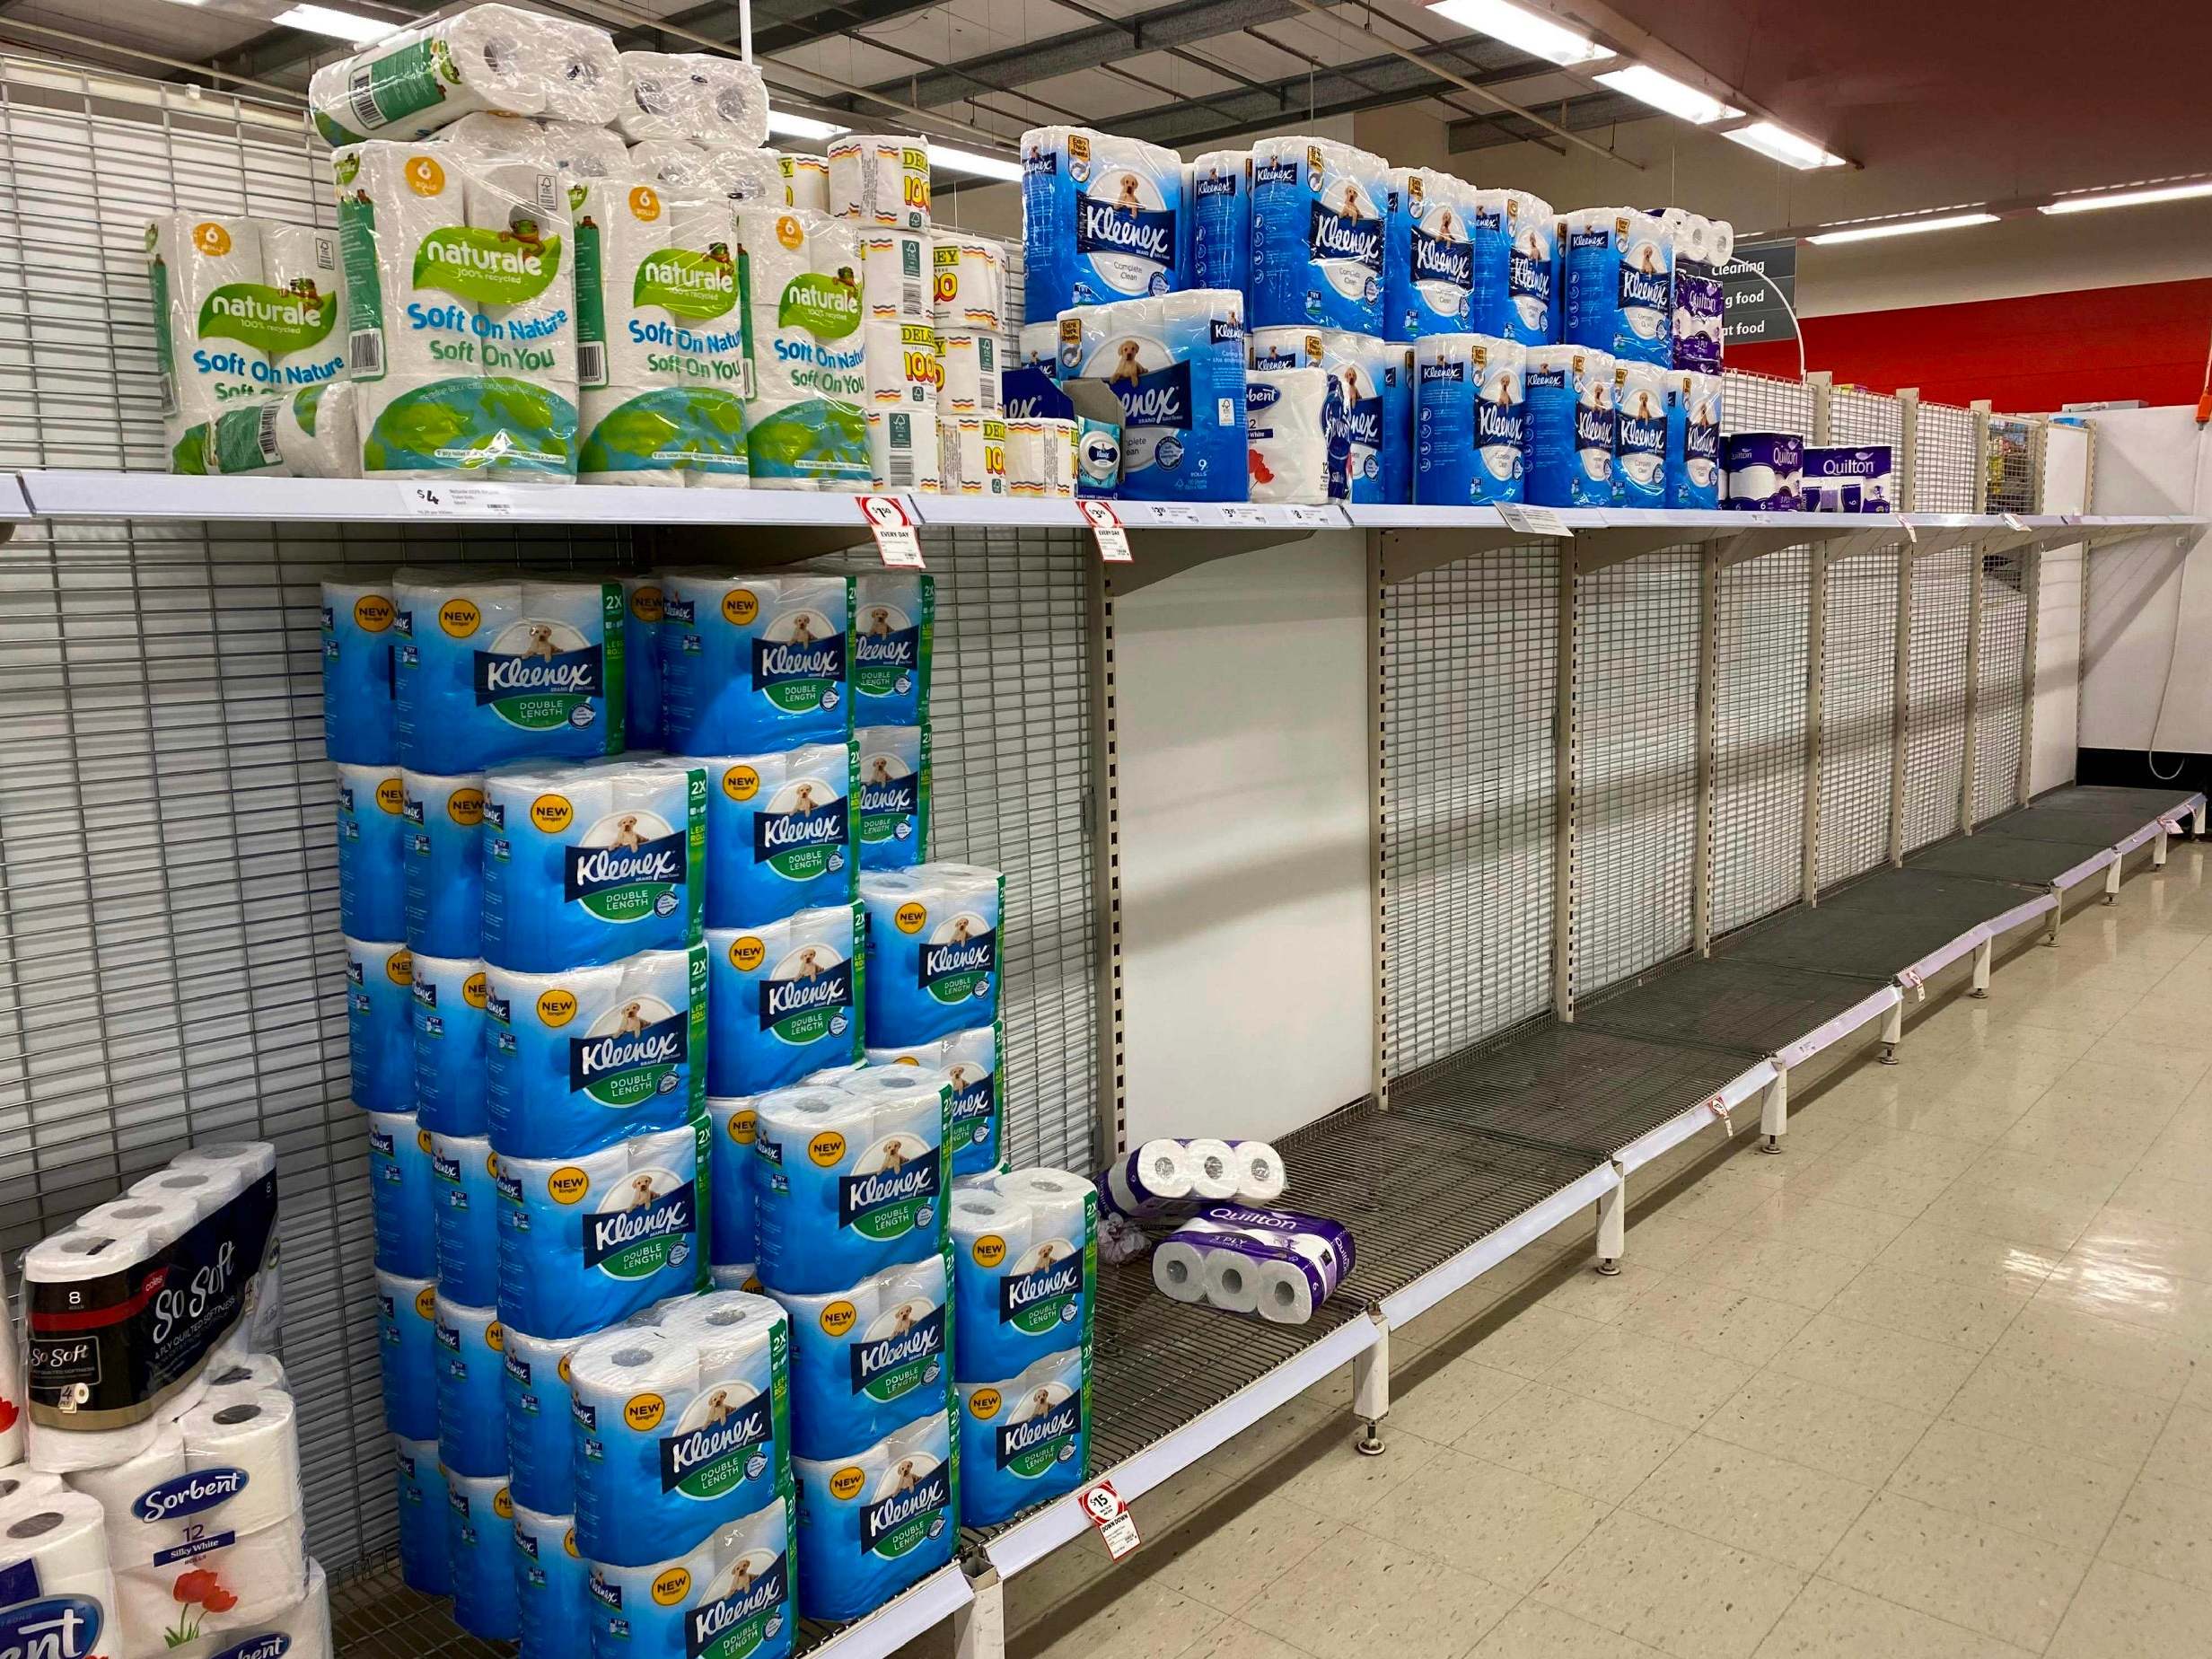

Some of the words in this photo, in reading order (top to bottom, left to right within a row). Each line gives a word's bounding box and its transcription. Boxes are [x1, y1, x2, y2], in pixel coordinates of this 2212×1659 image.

[417, 162, 432, 180] 6
[1257, 169, 1294, 180] Kleenex
[1198, 181, 1231, 194] Kleenex
[639, 190, 650, 206] 6
[206, 227, 219, 243] 6
[785, 220, 795, 235] 6
[1086, 206, 1168, 258] Kleenex
[1316, 214, 1379, 259] Kleenex
[1573, 235, 1605, 247] Kleenex
[427, 241, 542, 276] naturale
[1113, 261, 1143, 273] Complete
[1712, 260, 1764, 276] Cleaning
[485, 273, 522, 284] recycled
[645, 261, 733, 293] naturale
[789, 285, 859, 313] naturale
[1736, 289, 1764, 304] food
[212, 295, 321, 328] naturale
[241, 319, 265, 329] 100%
[267, 325, 301, 334] recycled
[408, 303, 464, 332] Soft
[471, 314, 504, 340] On
[508, 309, 568, 340] Nature
[1736, 320, 1765, 335] food
[628, 320, 673, 344] Soft
[677, 330, 704, 354] On
[430, 339, 474, 363] Soft
[481, 345, 512, 368] On
[514, 347, 556, 370] You
[816, 347, 836, 369] On
[193, 350, 245, 375] Soft
[250, 361, 281, 383] On
[286, 356, 345, 384] Nature
[647, 354, 682, 373] Soft
[686, 356, 709, 379] On
[713, 359, 741, 380] You
[1258, 360, 1289, 371] Kleenex
[1424, 366, 1461, 379] Kleenex
[791, 369, 818, 388] Soft
[821, 373, 841, 393] On
[843, 373, 865, 394] You
[1527, 374, 1561, 387] Kleenex
[1249, 389, 1277, 402] bent
[1122, 386, 1180, 424] enex
[1620, 417, 1665, 451] Kleenex
[1198, 459, 1207, 470] 9
[1773, 447, 1798, 466] Quilton
[1823, 459, 1874, 476] Quilton
[1760, 501, 1766, 510] 6
[606, 595, 622, 610] 2X
[727, 601, 753, 610] NEW
[359, 607, 390, 618] NEW
[444, 612, 475, 621] NEW
[856, 637, 911, 664] leenex
[762, 645, 838, 677] Kleenex
[487, 657, 592, 692] Kleenex
[861, 672, 891, 680] DOUBLE
[861, 677, 890, 685] LENGTH
[785, 685, 816, 695] DOUBLE
[785, 692, 816, 702] LENGTH
[520, 700, 563, 710] DOUBLE
[521, 708, 563, 718] LENGTH
[691, 781, 707, 795] 2X
[728, 777, 755, 786] NEW
[452, 801, 484, 811] NEW
[861, 786, 910, 813] leenex
[536, 806, 567, 817] NEW
[765, 814, 840, 848] Kleenex
[864, 819, 891, 829] DOUBLE
[864, 825, 890, 835] LENGTH
[788, 850, 822, 864] DOUBLE
[789, 857, 822, 872] LENGTH
[576, 849, 676, 887] Kleenex
[606, 890, 648, 903] DOUBLE
[606, 898, 648, 911] LENGTH
[900, 913, 923, 921] NEW
[734, 947, 760, 957] NEW
[927, 945, 988, 976] Kleenex
[692, 960, 707, 976] 2X
[692, 961, 707, 976] 2X
[944, 977, 971, 989] DOUBLE
[944, 983, 971, 996] LENGTH
[769, 979, 844, 1014] Kleenex
[542, 1001, 572, 1014] NEW
[791, 1014, 823, 1028] DOUBLE
[791, 1021, 823, 1035] LENGTH
[582, 1032, 678, 1075] Kleenex
[610, 1073, 652, 1090] DOUBLE
[611, 1082, 652, 1097] LENGTH
[698, 1128, 711, 1145] 2X
[813, 1141, 841, 1154] NEW
[553, 1177, 584, 1189] NEW
[850, 1168, 932, 1211] Kleenex
[874, 1207, 908, 1224] DOUBLE
[876, 1214, 909, 1231] LENGTH
[1210, 1208, 1296, 1230] Quilton
[595, 1205, 686, 1251] Kleenex
[623, 1243, 662, 1262] DOUBLE
[977, 1244, 1002, 1256] NEW
[624, 1252, 662, 1270] LENGTH
[145, 1275, 163, 1292] coles
[153, 1288, 185, 1344] So
[189, 1240, 234, 1318] Soft
[1009, 1270, 1076, 1309] Kleenex
[69, 1291, 81, 1304] 8
[825, 1312, 852, 1322] NEW
[1029, 1303, 1057, 1318] DOUBLE
[1029, 1310, 1057, 1325] LENGTH
[172, 1320, 204, 1347] QUILTED
[773, 1331, 786, 1350] 2X
[31, 1347, 48, 1366] So
[50, 1345, 89, 1367] Soft
[861, 1330, 939, 1377] Kleenex
[885, 1366, 918, 1387] DOUBLE
[886, 1374, 918, 1395] LENGTH
[629, 1403, 661, 1416] NEW
[973, 1396, 998, 1408] NEW
[1005, 1411, 1075, 1454] Kleenex
[673, 1413, 763, 1473] Kleenex
[1024, 1444, 1055, 1464] DOUBLE
[1025, 1453, 1055, 1470] LENGTH
[700, 1457, 738, 1481] DOUBLE
[702, 1466, 739, 1489] LENGTH
[835, 1475, 861, 1488] NEW
[143, 1472, 241, 1523] Sorbent
[1090, 1494, 1108, 1506] $15
[871, 1482, 943, 1537] Kleenex
[1102, 1521, 1115, 1532] DOWN
[1115, 1514, 1128, 1524] DOWN
[183, 1524, 205, 1541] 12
[892, 1522, 924, 1543] DOUBLE
[894, 1529, 924, 1550] LENGTH
[170, 1546, 191, 1558] Silky
[192, 1539, 218, 1553] White
[657, 1575, 686, 1593] NEW
[696, 1576, 778, 1643] Kleenex
[723, 1621, 758, 1650] DOUBLE
[724, 1629, 758, 1656] LENGTH
